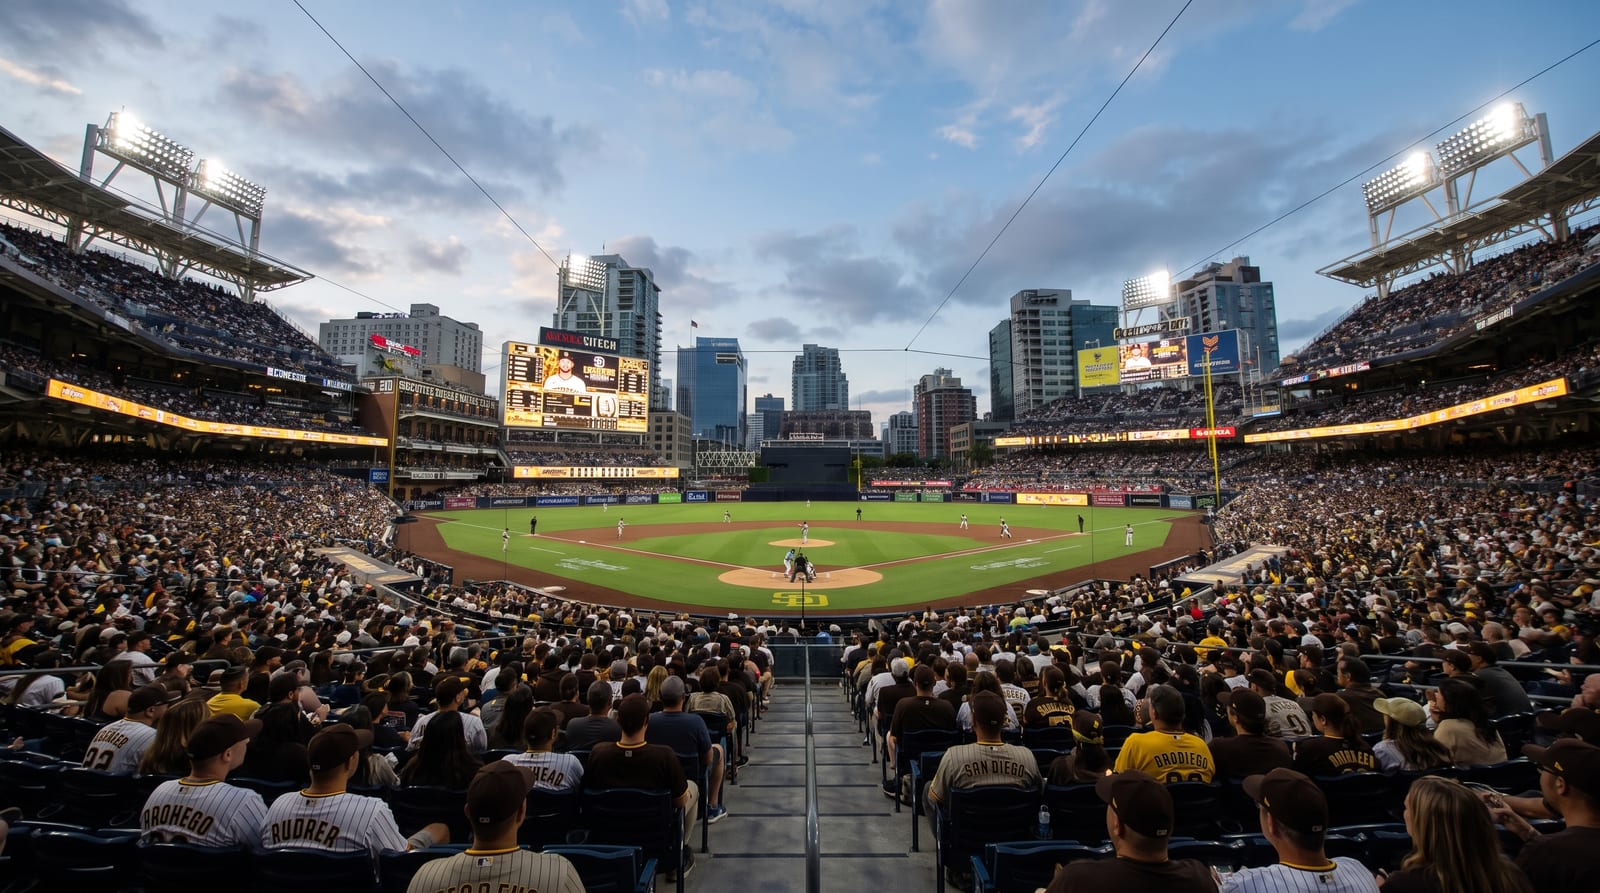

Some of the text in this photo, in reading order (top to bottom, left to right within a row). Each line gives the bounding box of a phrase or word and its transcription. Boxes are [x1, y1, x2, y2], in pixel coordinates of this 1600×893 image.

[771, 591, 829, 607] SD
[964, 760, 1025, 778] SAN DIEGO
